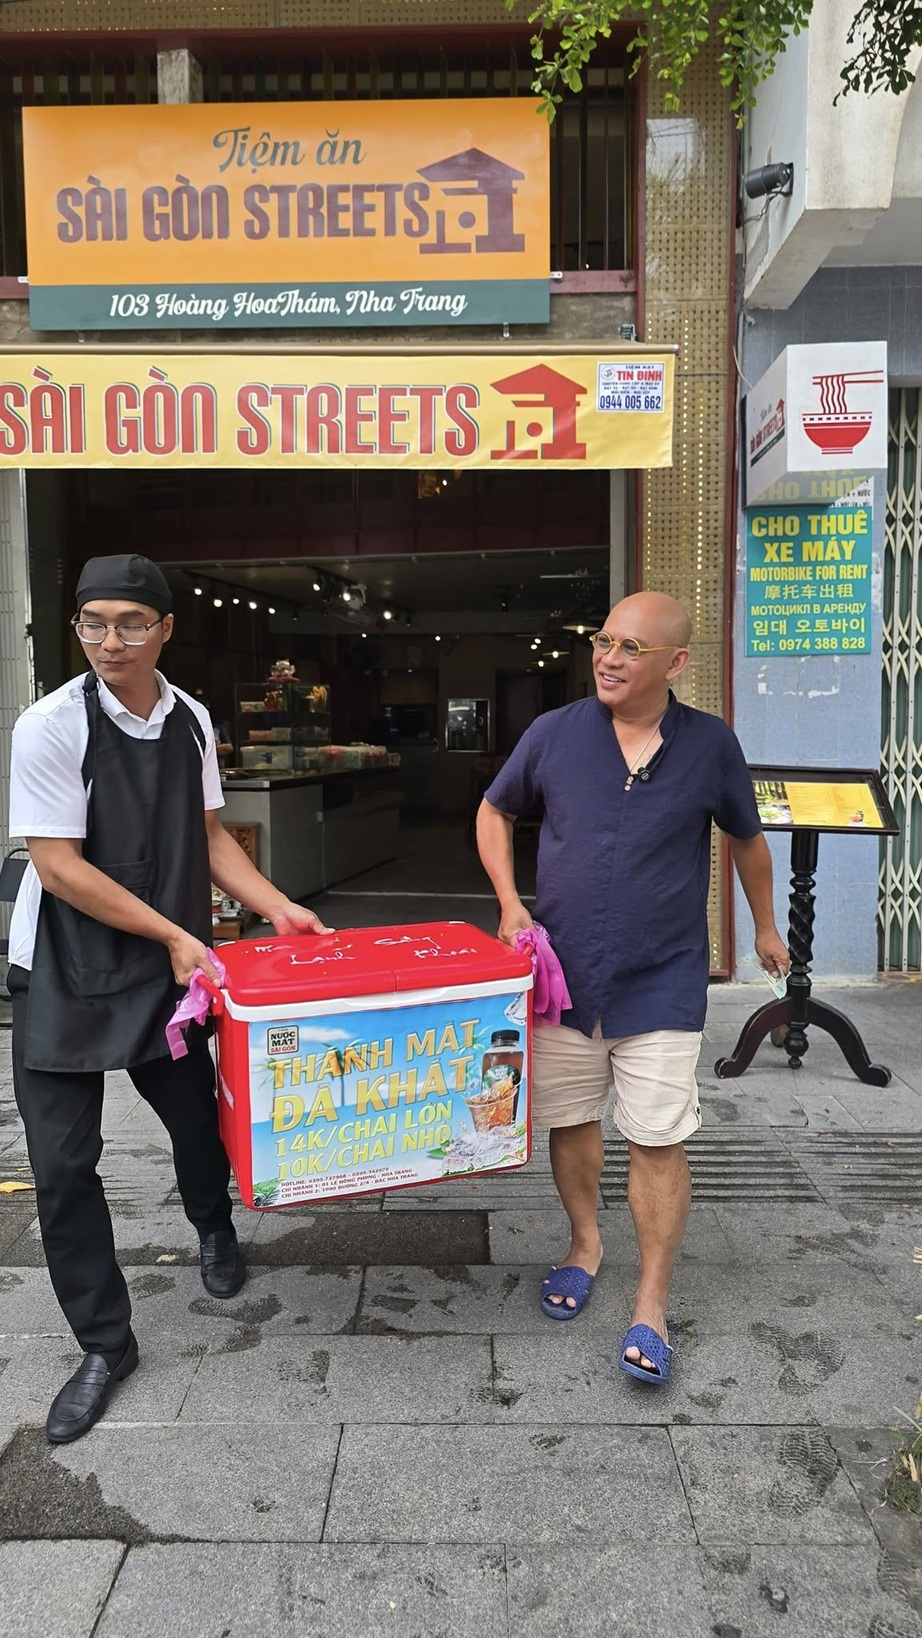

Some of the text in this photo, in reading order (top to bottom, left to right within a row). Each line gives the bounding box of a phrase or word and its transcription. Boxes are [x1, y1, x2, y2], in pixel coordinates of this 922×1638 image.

[212, 126, 367, 174] Tiệm ăn
[57, 174, 430, 243] SÀI GÒN STREETS
[109, 293, 149, 317] 103
[155, 292, 229, 321] Hoàng
[346, 290, 396, 317] Nha
[400, 287, 468, 317] Trang
[617, 370, 634, 381] TIN
[0, 365, 480, 456] SÀI GÒN STREETS
[600, 395, 661, 409] 0944 005 662
[751, 509, 868, 538] CHO THUÊ
[764, 536, 856, 562] XE MÁY
[750, 564, 868, 581] MOTORBIKE FOR RENT
[764, 583, 854, 600] 摩托车出租
[751, 602, 866, 616] МОТОЦИКЛ В АРЕНДУ
[753, 617, 865, 636] 임대 오토바이
[751, 637, 865, 651] Tel: 0974 388 828
[269, 1019, 480, 1089] THÁNH MÁT
[270, 1055, 475, 1134] ĐÃ KHÁT
[275, 1100, 453, 1158] 14K/CHAI LỚN
[276, 1139, 396, 1182] 10K/CHAI
